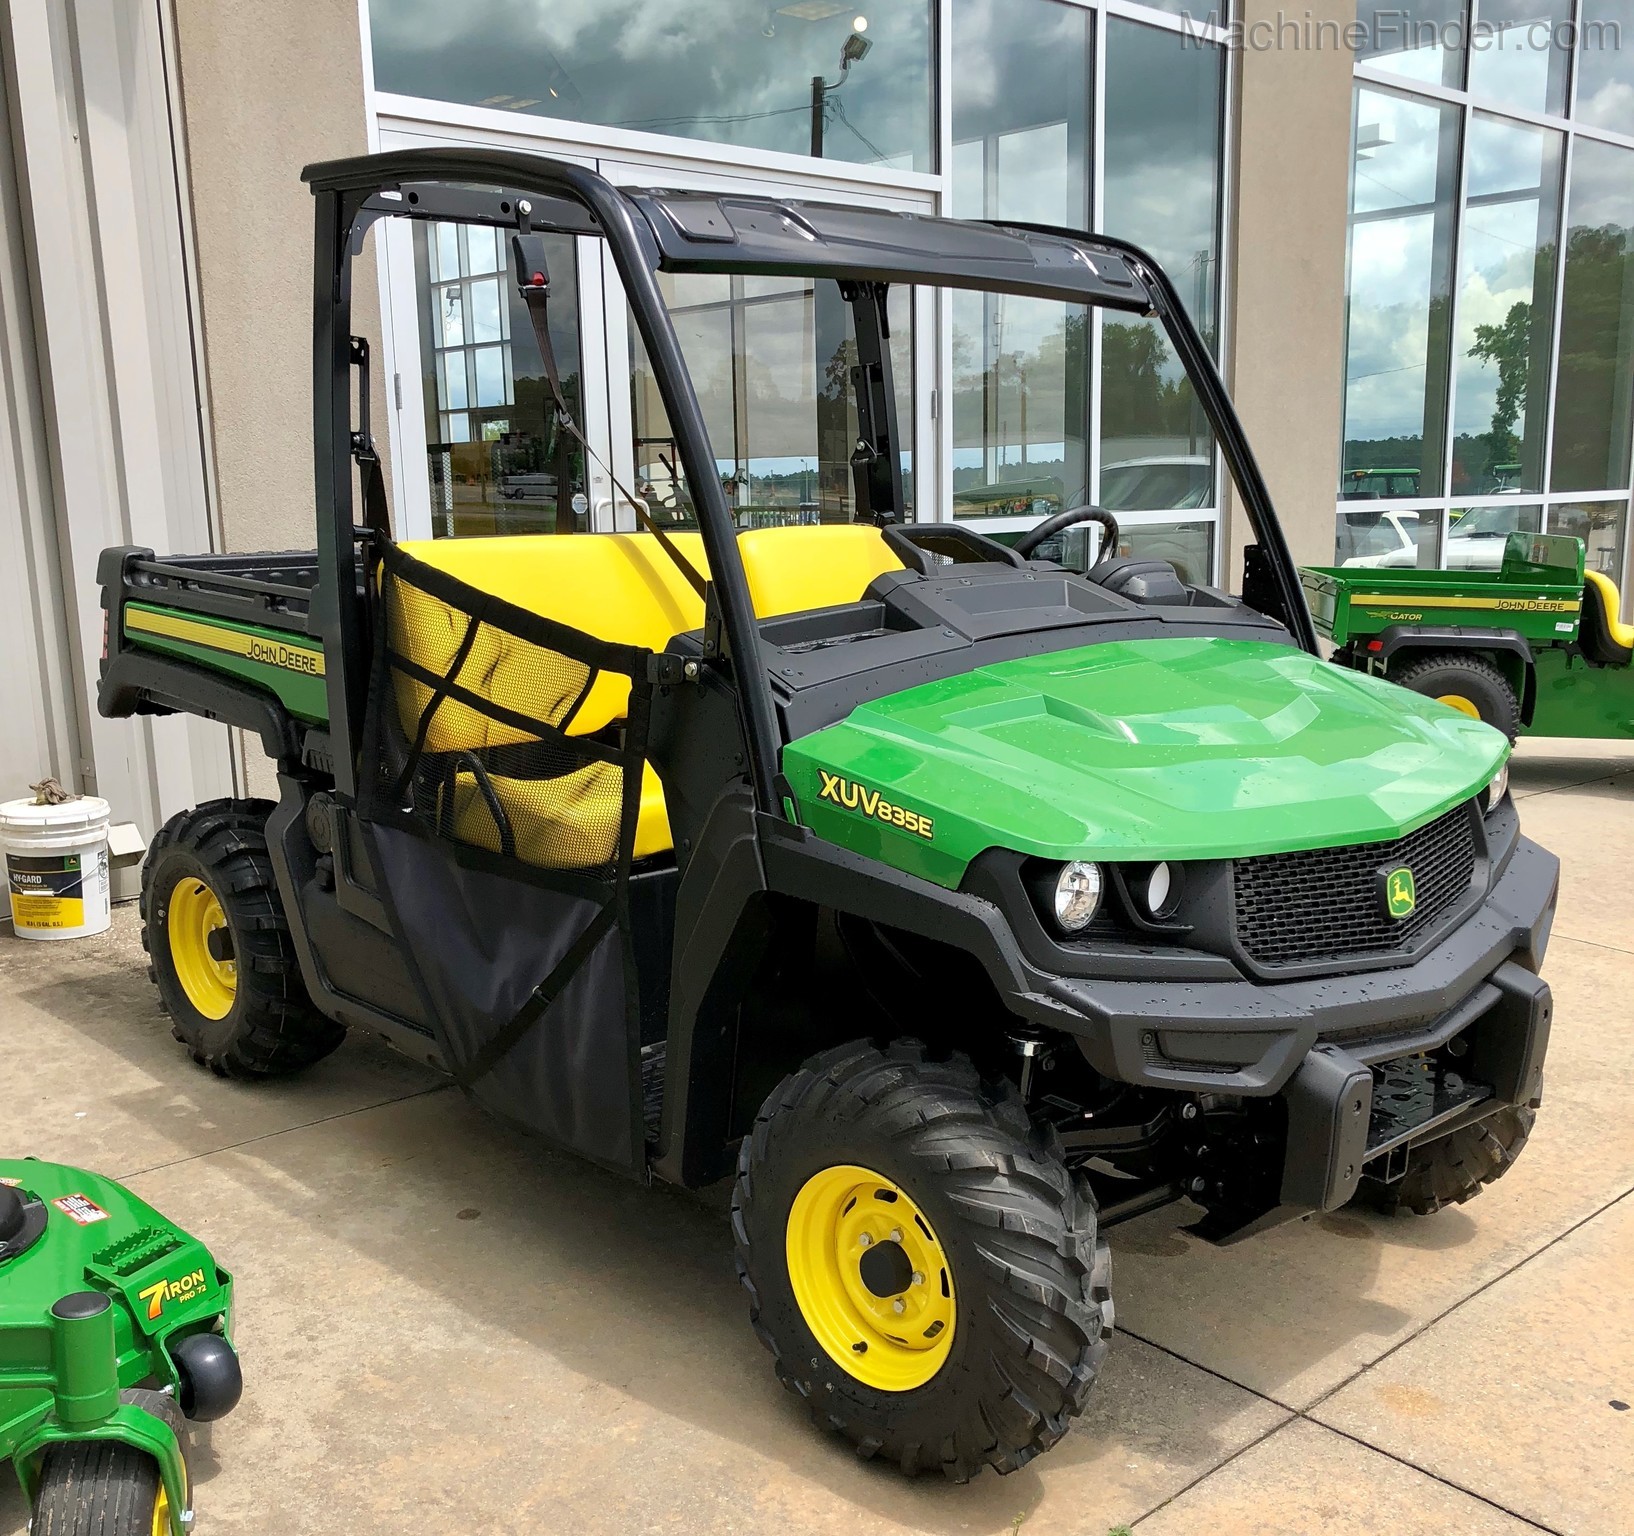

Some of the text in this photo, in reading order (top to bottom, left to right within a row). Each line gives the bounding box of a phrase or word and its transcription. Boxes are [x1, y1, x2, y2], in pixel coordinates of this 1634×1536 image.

[1494, 600, 1564, 611] JOHN DEERE
[1390, 612, 1422, 621] GATOR
[246, 639, 317, 672] JOHN DEERE
[817, 768, 933, 841] XUV835E
[179, 1285, 207, 1303] PRO 72
